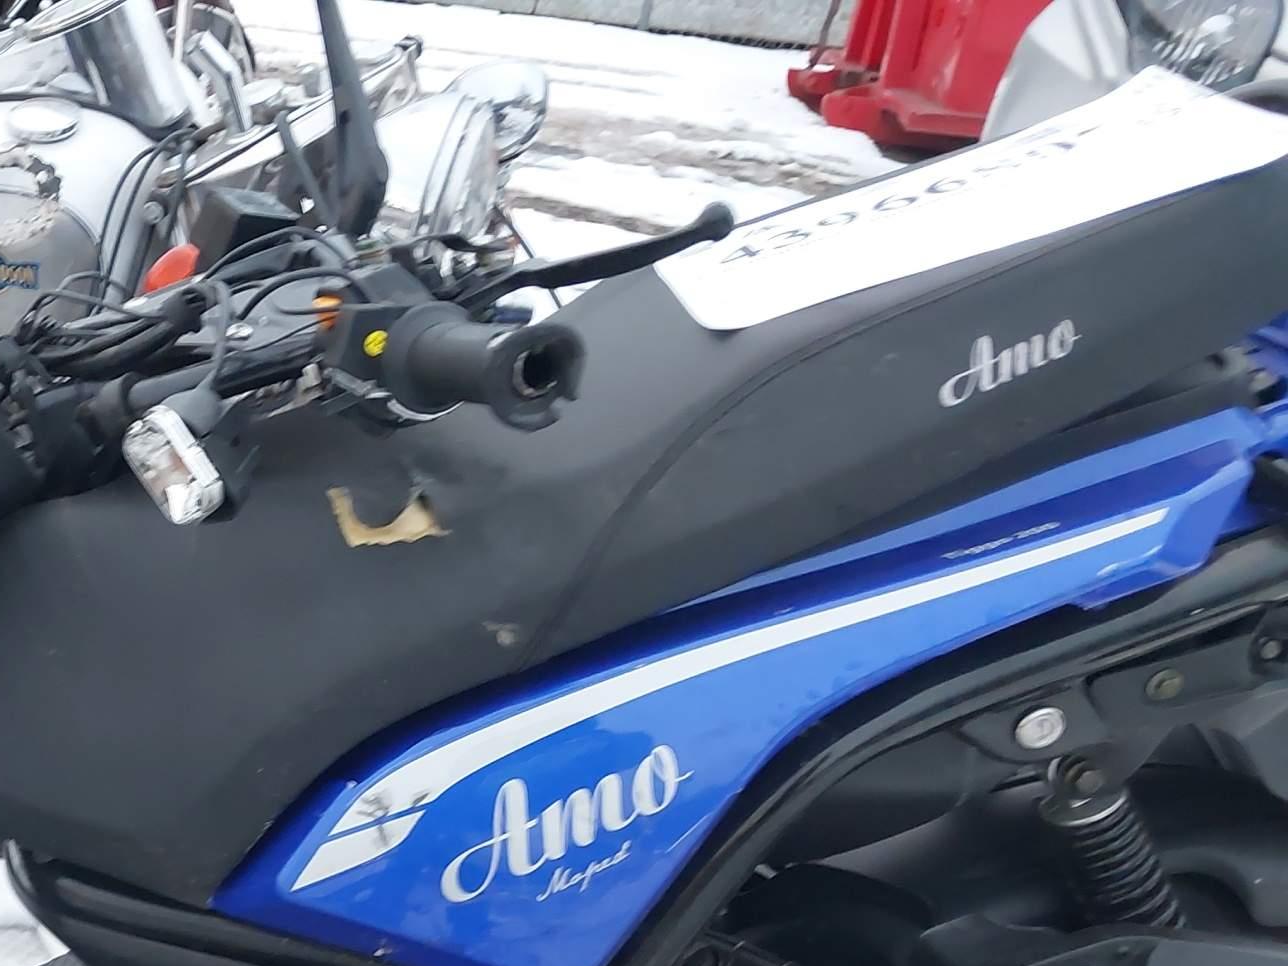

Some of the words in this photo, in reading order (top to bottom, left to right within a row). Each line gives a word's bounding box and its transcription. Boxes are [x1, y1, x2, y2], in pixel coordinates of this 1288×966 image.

[938, 319, 1082, 408] Amo
[440, 744, 695, 903] Amo
[536, 839, 632, 902] Moped
